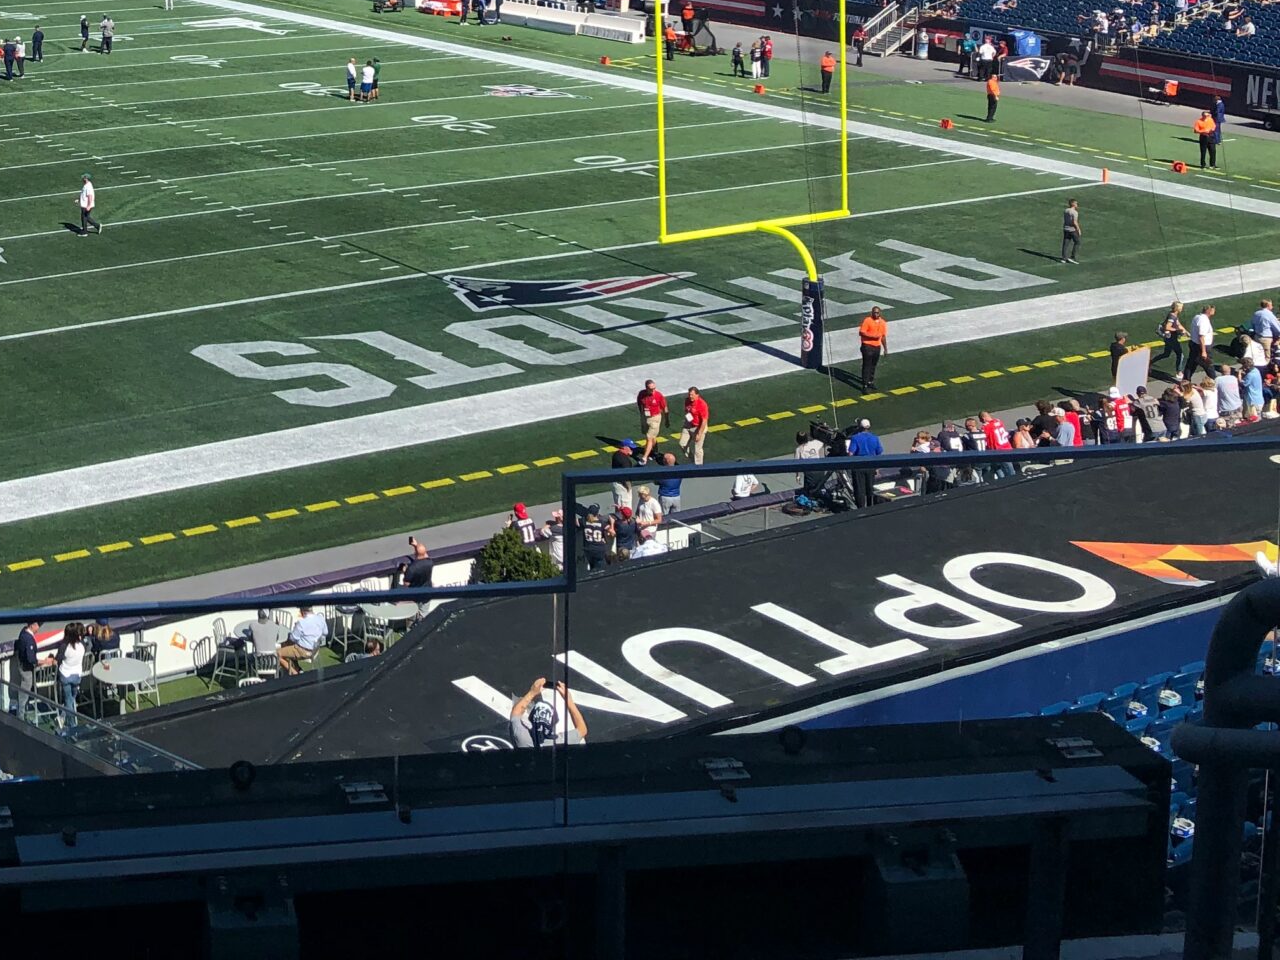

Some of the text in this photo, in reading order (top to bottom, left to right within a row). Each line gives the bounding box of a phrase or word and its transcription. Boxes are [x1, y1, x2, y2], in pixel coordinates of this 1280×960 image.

[190, 239, 1057, 407] PATRIOTS
[995, 427, 1009, 445] 12
[522, 525, 535, 542] 11
